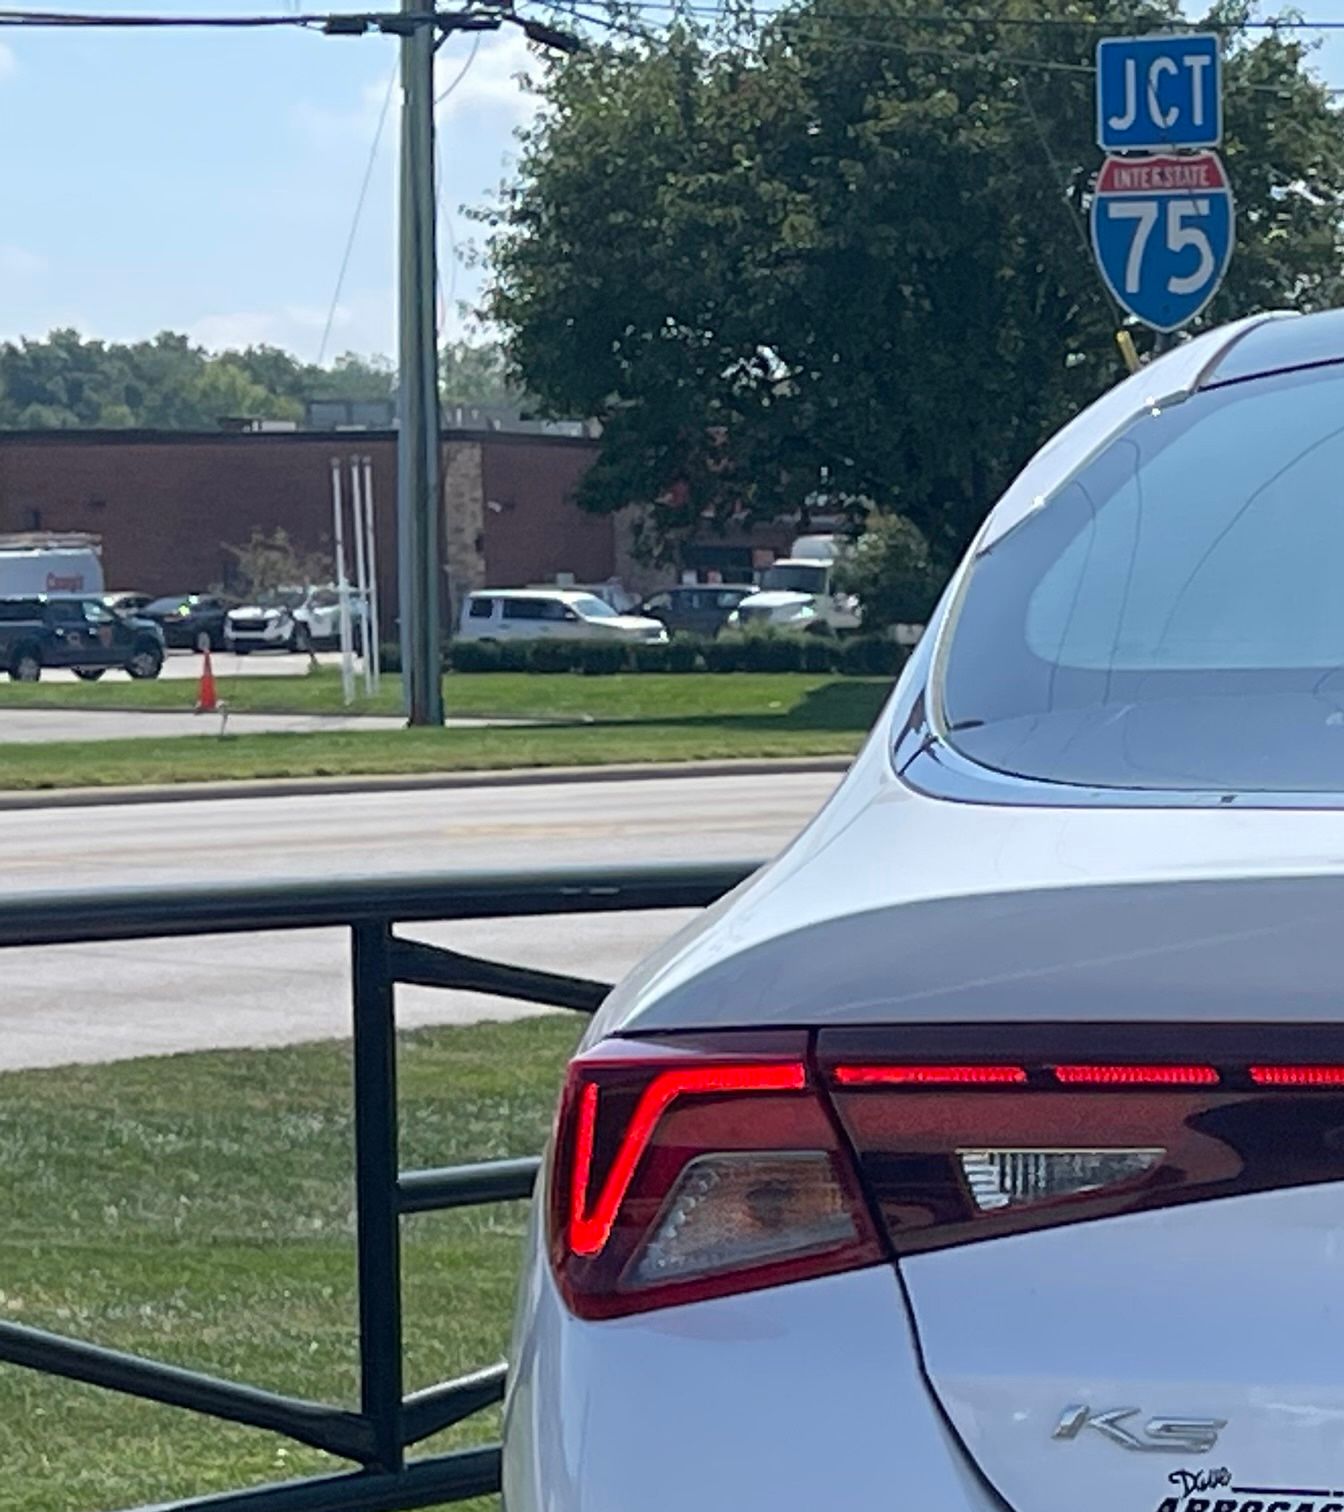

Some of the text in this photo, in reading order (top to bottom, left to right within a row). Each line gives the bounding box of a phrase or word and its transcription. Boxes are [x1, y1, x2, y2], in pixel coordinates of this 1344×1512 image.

[1108, 55, 1211, 131] JCT
[1113, 164, 1211, 189] INTERSTATE
[1108, 199, 1214, 295] 75
[1050, 1404, 1228, 1454] K5
